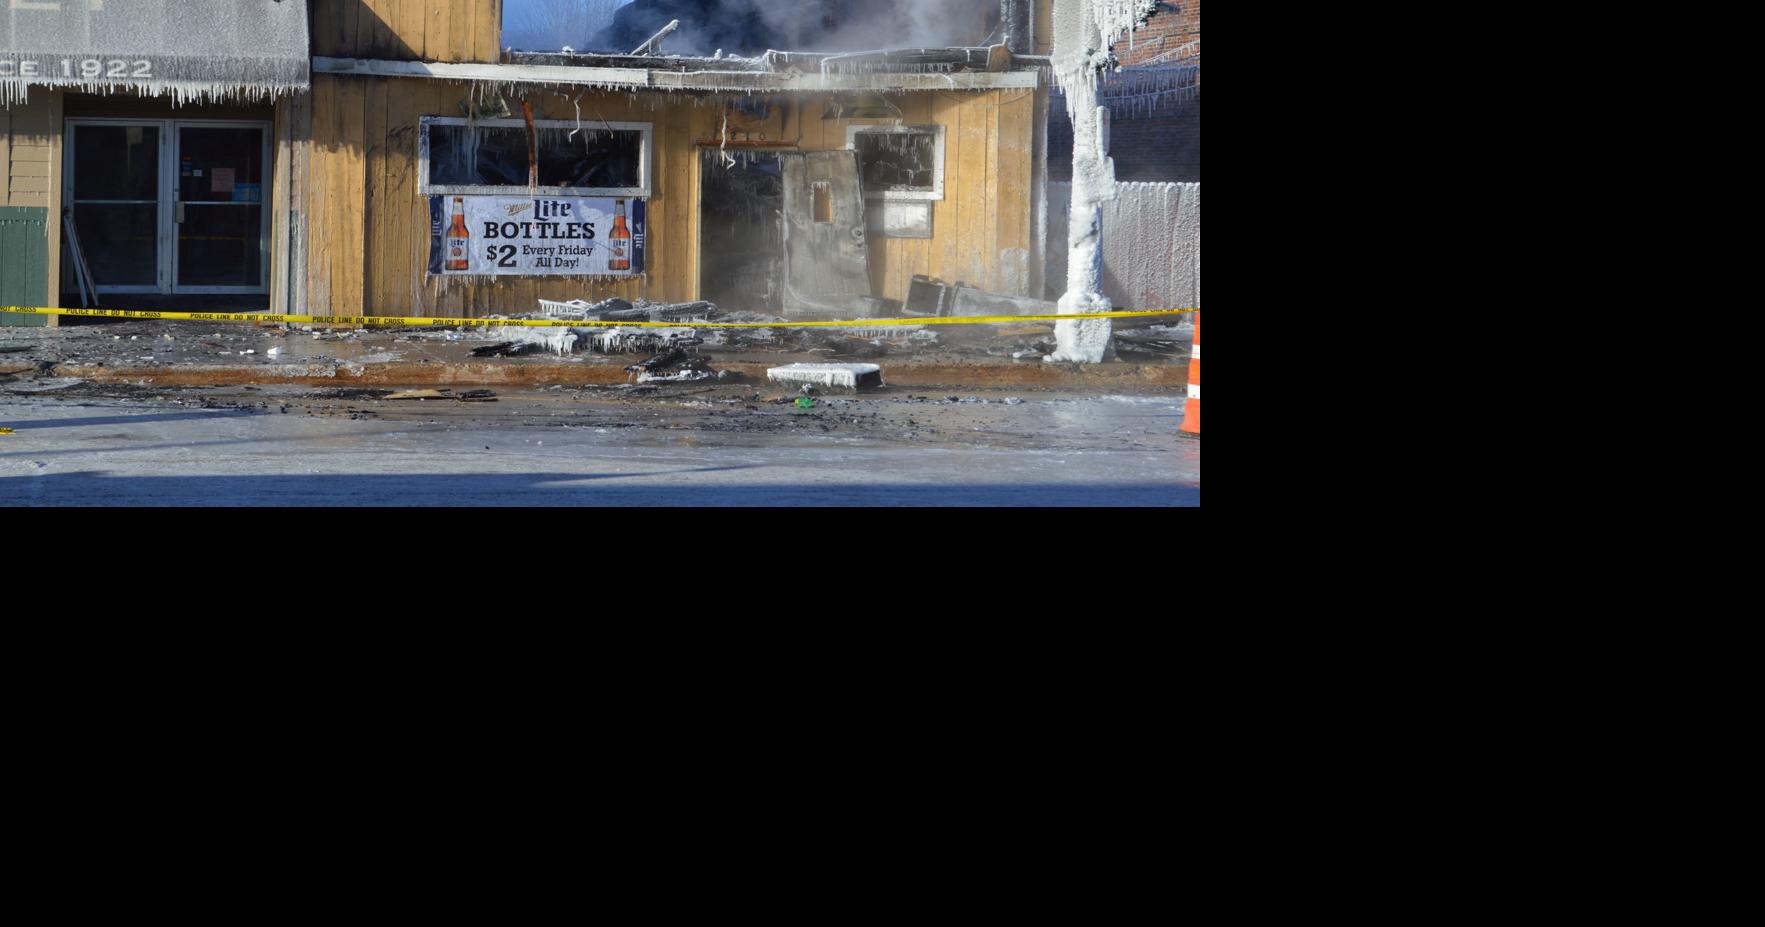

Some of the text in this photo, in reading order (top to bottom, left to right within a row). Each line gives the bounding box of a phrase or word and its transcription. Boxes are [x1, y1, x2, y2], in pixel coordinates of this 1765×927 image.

[60, 58, 152, 78] 1922
[504, 199, 572, 221] Miller Lite
[483, 222, 595, 239] BOTTLES
[486, 244, 518, 268] $2
[522, 245, 593, 257] Every Friday
[535, 257, 579, 269] All Day!
